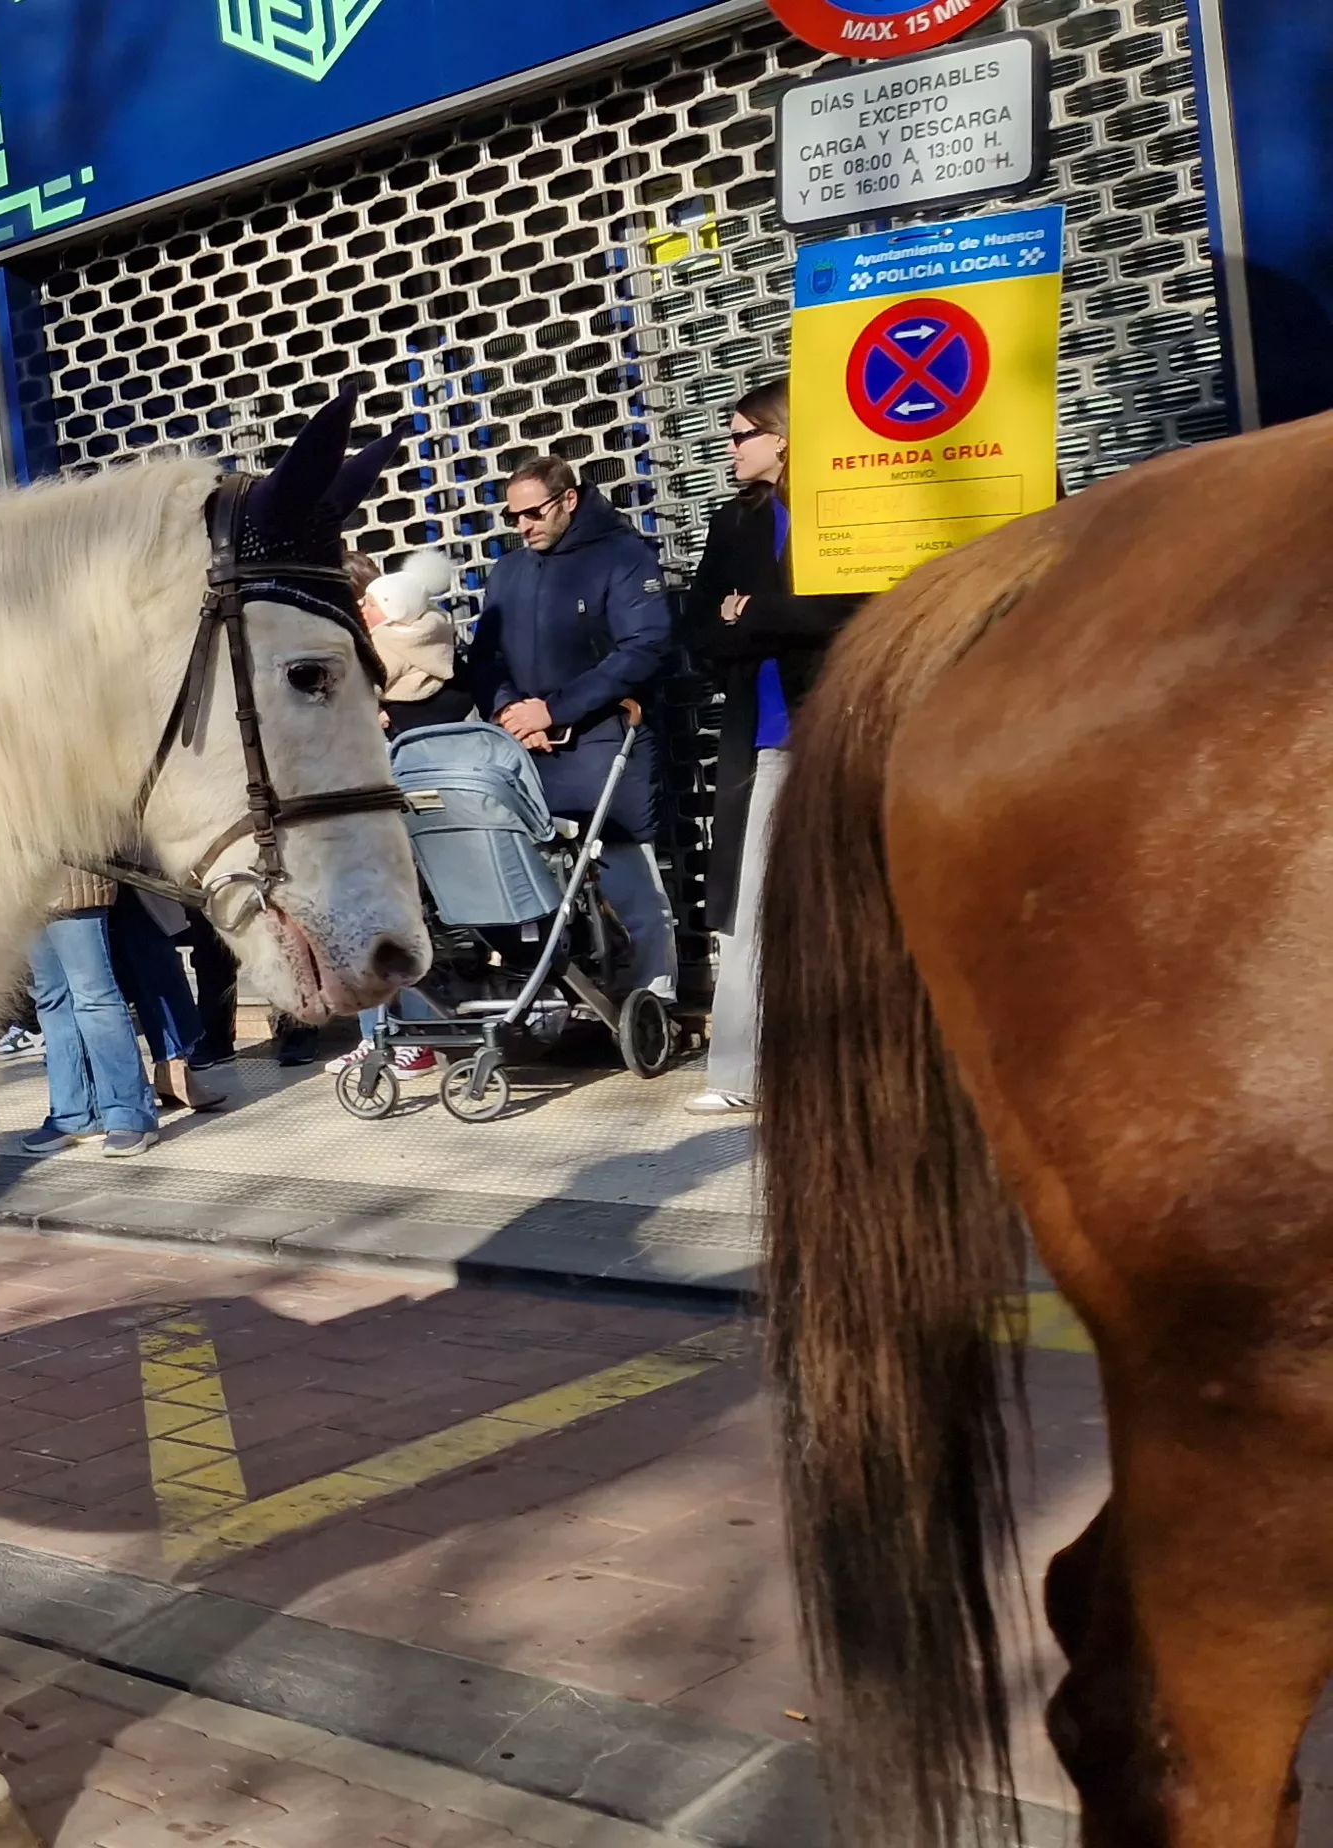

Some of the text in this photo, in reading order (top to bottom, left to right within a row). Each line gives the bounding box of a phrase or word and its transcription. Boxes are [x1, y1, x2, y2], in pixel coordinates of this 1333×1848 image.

[840, 19, 898, 42] MAX.
[904, 12, 931, 35] 15
[810, 61, 1001, 116] DÍAS LABORABLES
[859, 95, 949, 128] EXCEPTO
[799, 106, 1012, 162] CARGA Y DESCARGA
[808, 163, 834, 182] DE
[843, 152, 892, 176] 08:00
[927, 136, 974, 159] 13:00
[983, 131, 1002, 149] H.
[798, 151, 1014, 206] Y DE 16:00 A 20:00 H.
[853, 228, 1045, 268] Ayuntamiento de Huesca
[875, 253, 1012, 285] POLICÍA LOCAL
[832, 440, 1004, 471] RETIRADA GRÚA
[890, 469, 937, 481] MOTIVO:
[818, 531, 855, 542] FECHA:
[836, 564, 905, 576] Agradecemos
